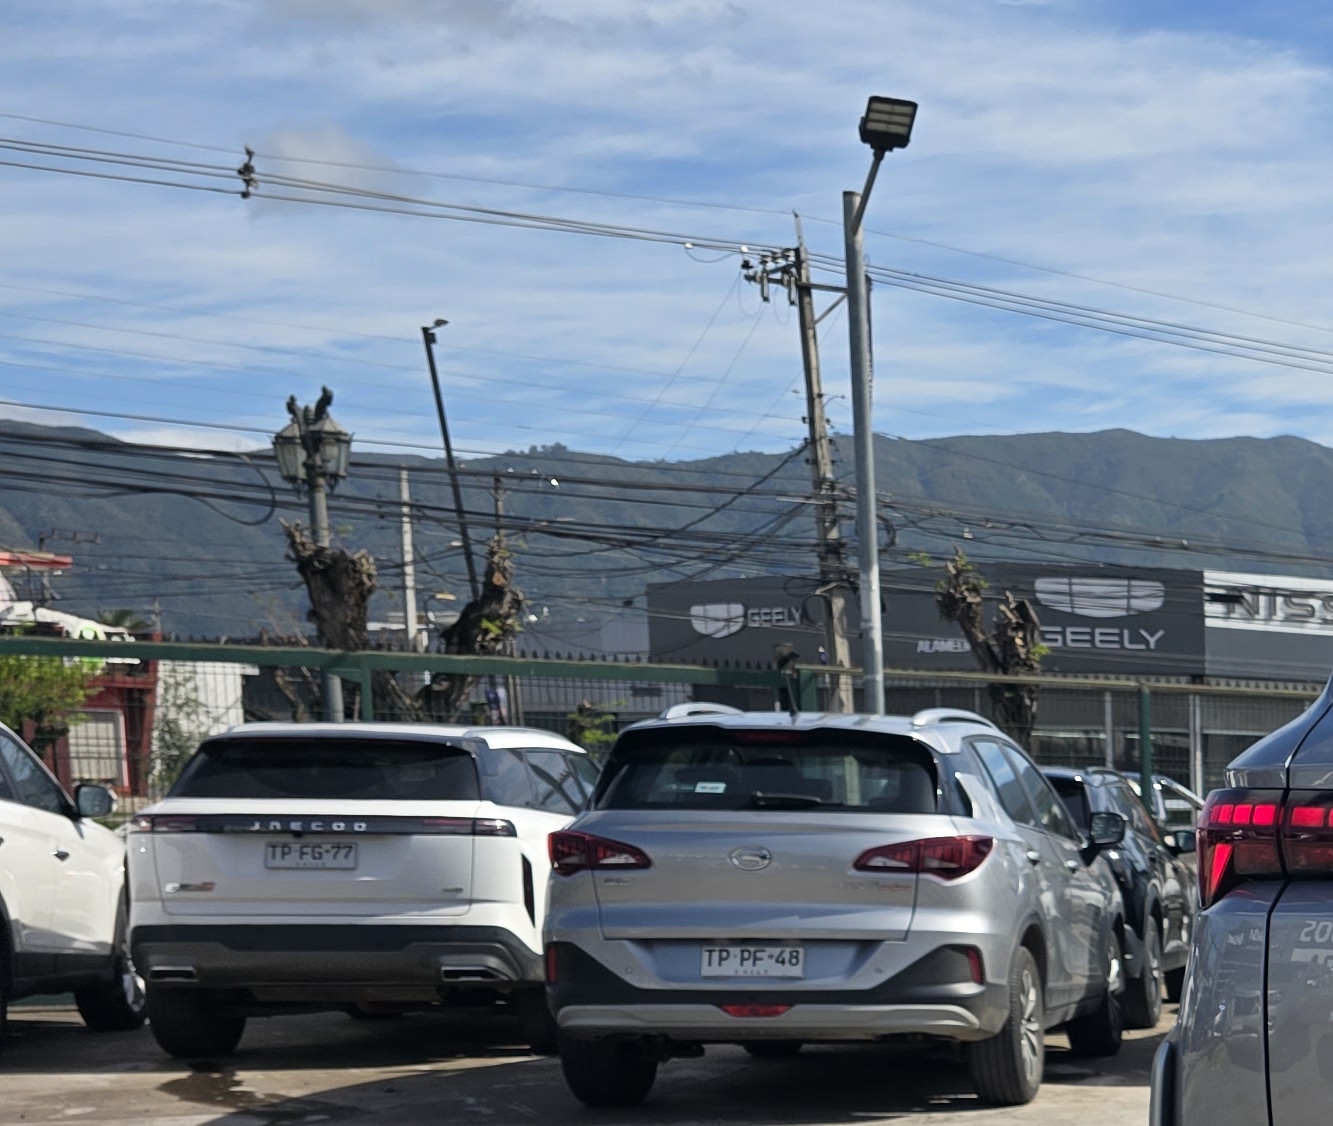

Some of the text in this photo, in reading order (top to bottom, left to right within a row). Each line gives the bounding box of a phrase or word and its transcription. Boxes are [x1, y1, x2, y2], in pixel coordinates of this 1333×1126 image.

[747, 605, 803, 628] GEELY
[917, 638, 972, 653] ALAMED
[1040, 626, 1166, 650] GEELY
[250, 821, 367, 831] JAECOO
